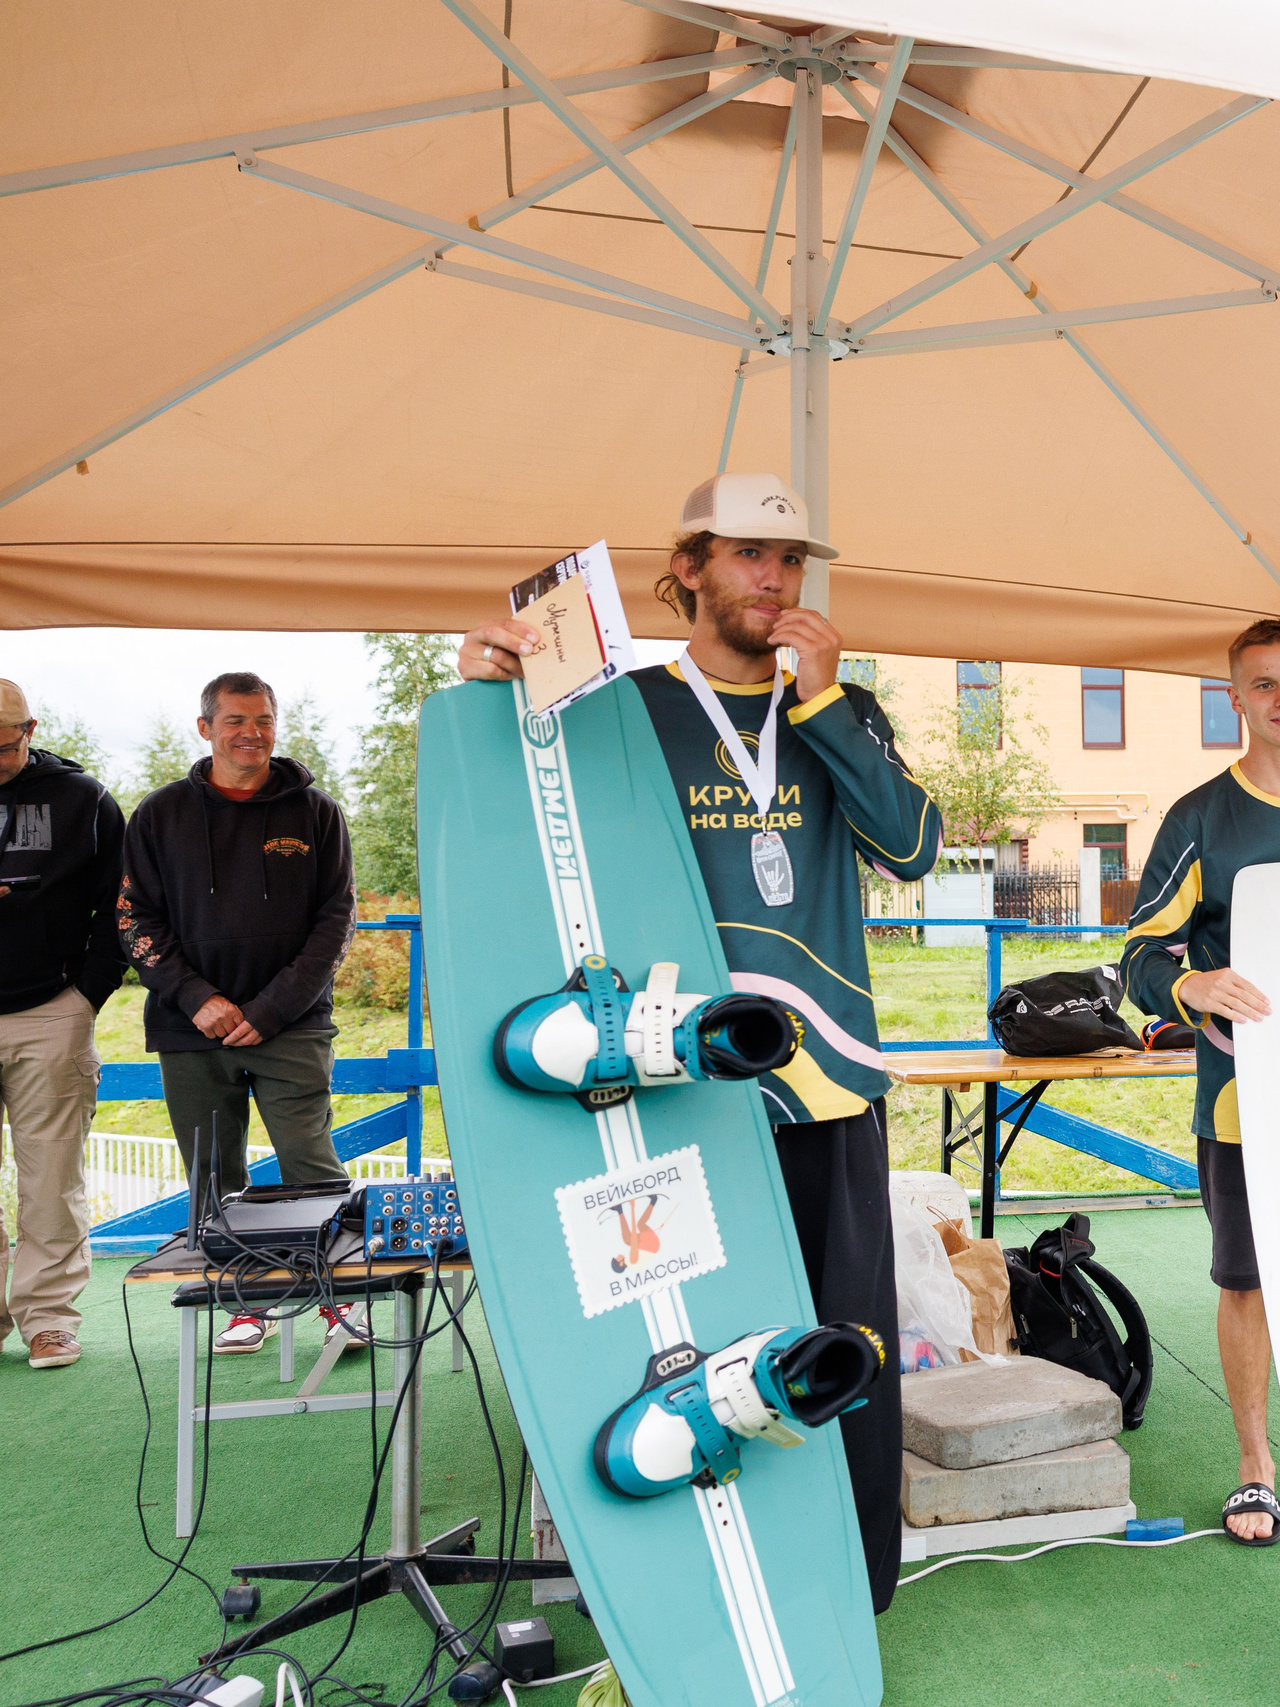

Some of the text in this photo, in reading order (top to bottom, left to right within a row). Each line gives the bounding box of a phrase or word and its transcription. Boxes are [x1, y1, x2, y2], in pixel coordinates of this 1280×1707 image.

[542, 602, 567, 663] Мужчины
[688, 784, 801, 806] КРУИ
[690, 811, 802, 830] на воде
[583, 1166, 682, 1210] ВЕЙКБОРД
[609, 1252, 699, 1296] В МАССЫ!
